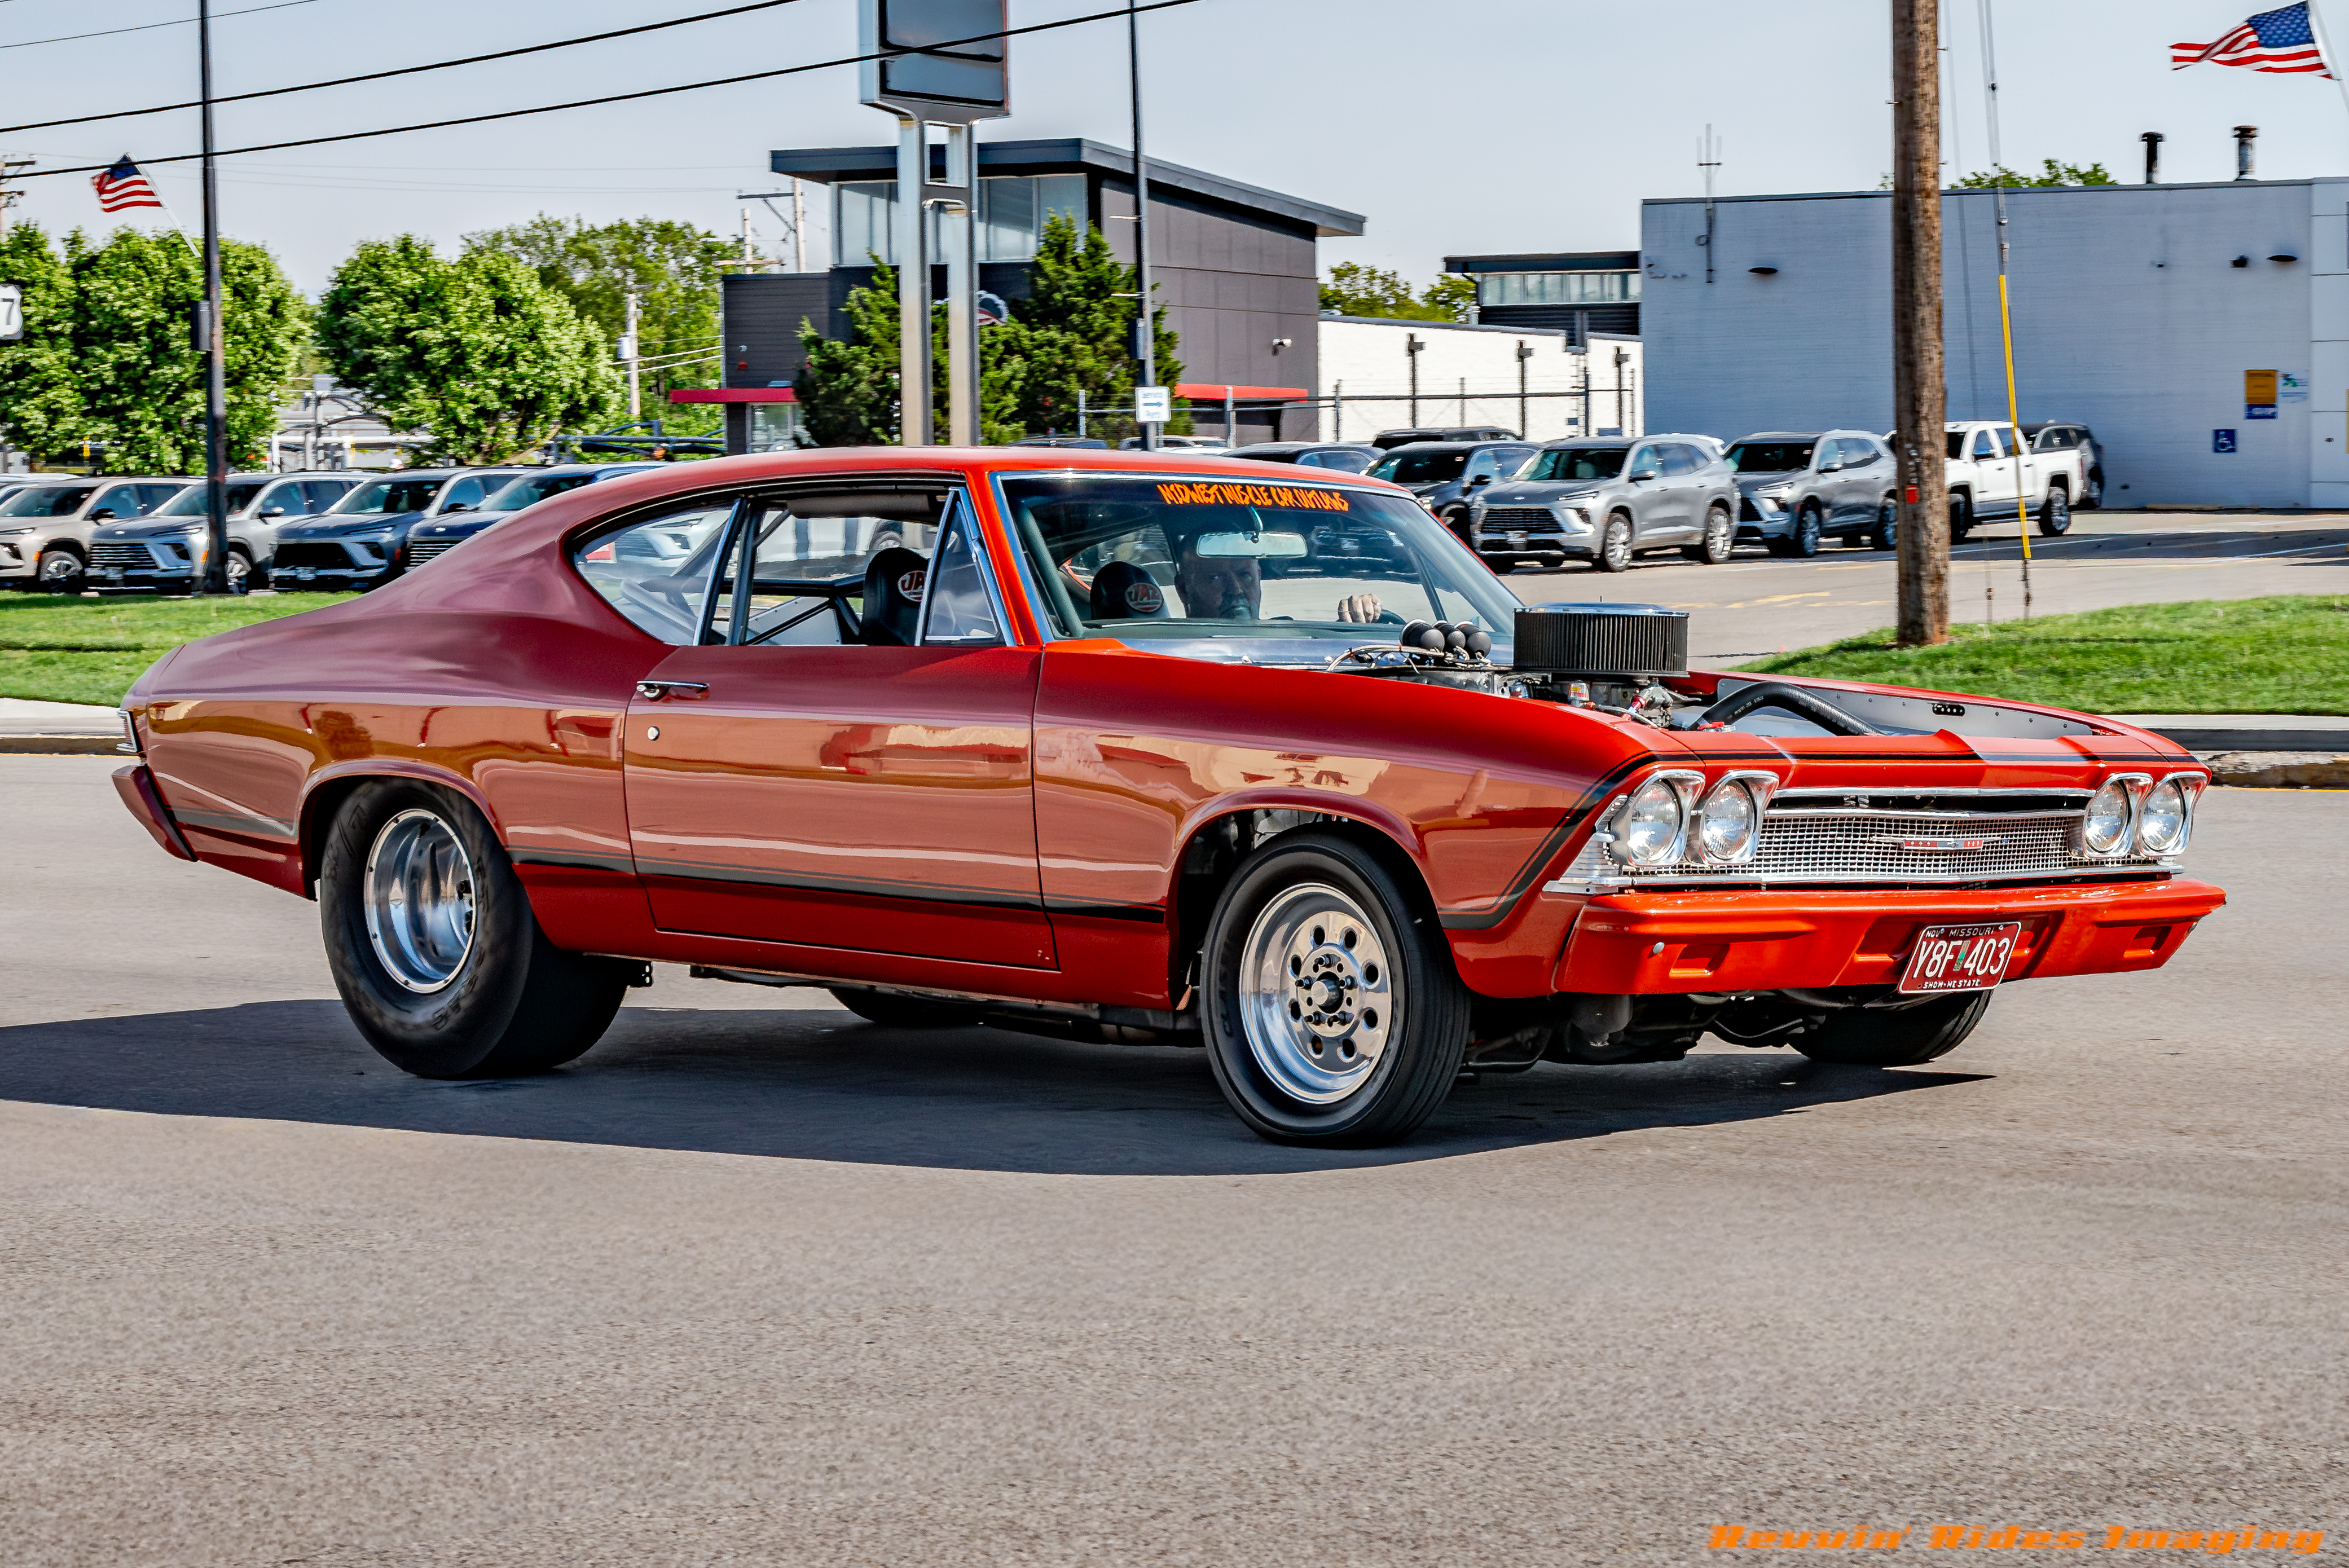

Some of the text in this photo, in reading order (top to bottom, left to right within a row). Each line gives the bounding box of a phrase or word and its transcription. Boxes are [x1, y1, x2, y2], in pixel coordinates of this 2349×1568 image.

[1156, 483, 1349, 512] MIDWEST MUSCLE CAR OUTLAWS
[900, 571, 925, 592] JA
[1948, 928, 1994, 936] MISSOURI
[1913, 937, 2010, 978] Y8F 403
